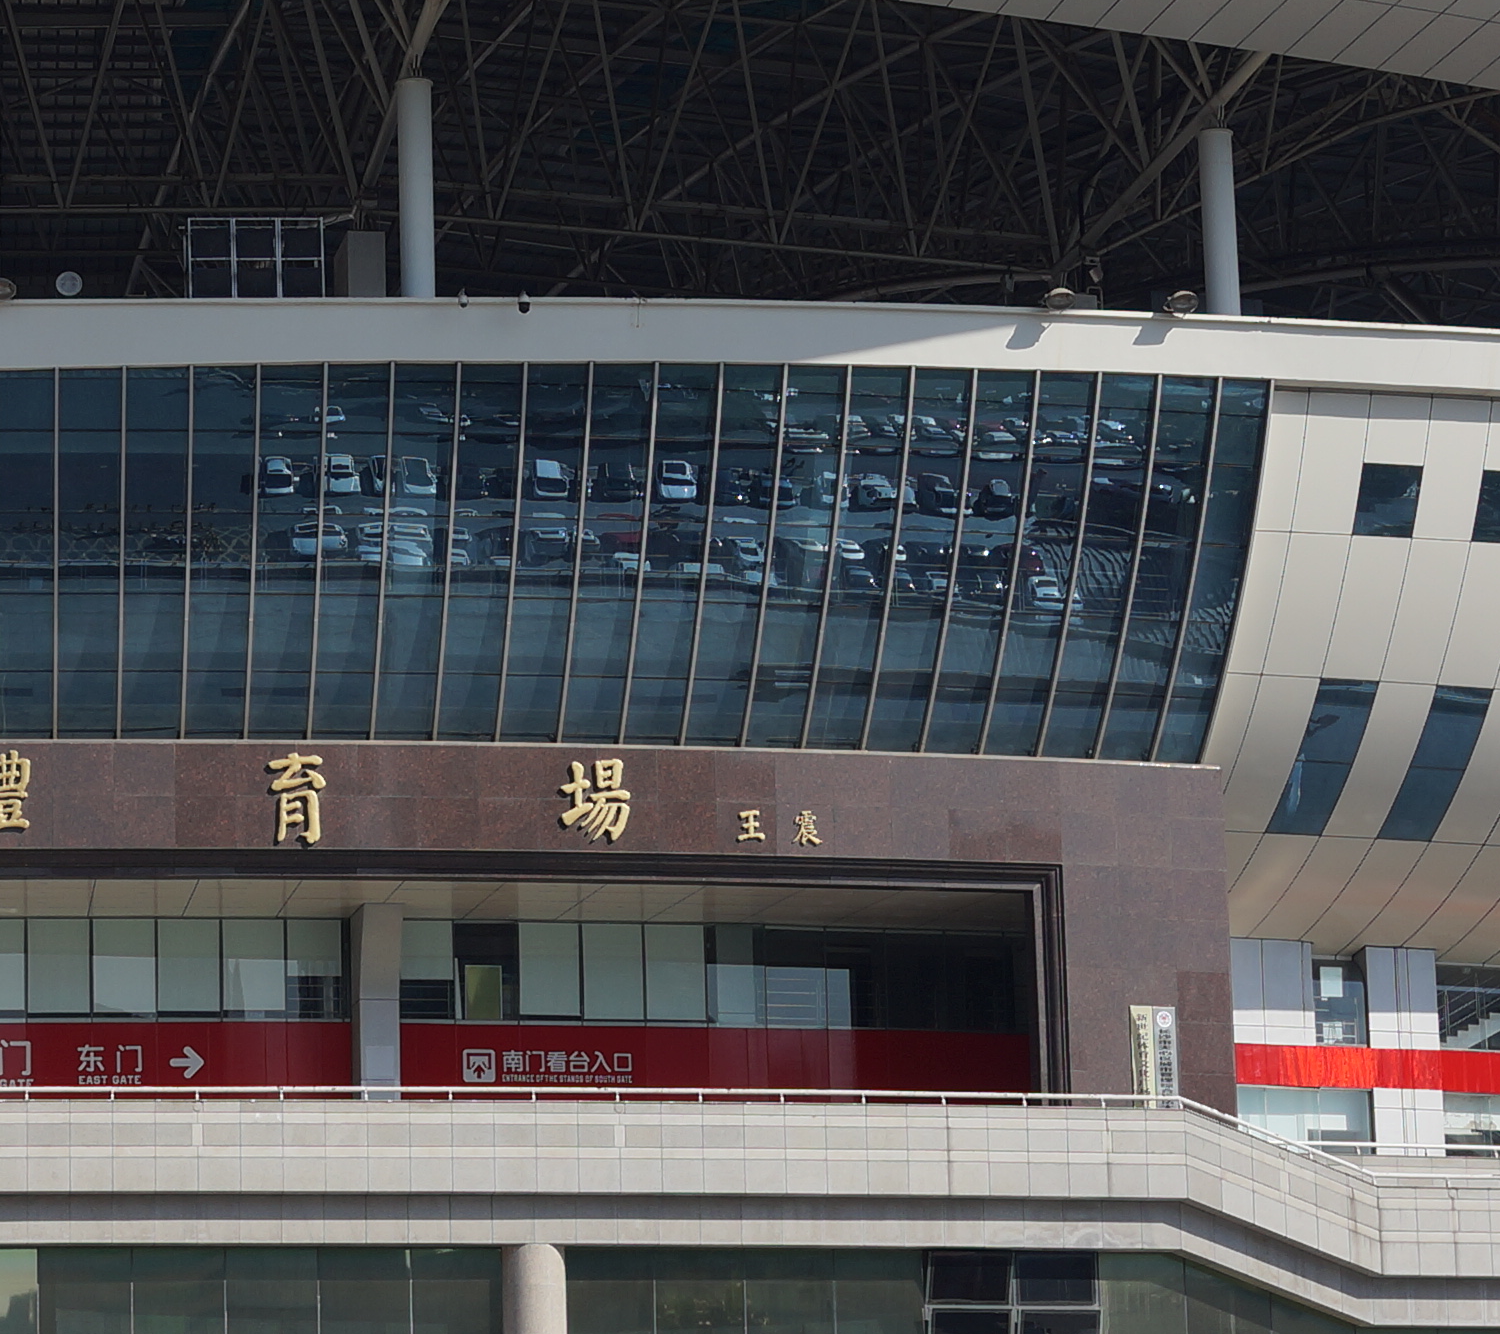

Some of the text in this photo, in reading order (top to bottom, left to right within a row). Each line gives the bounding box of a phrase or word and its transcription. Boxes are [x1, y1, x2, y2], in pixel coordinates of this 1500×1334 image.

[77, 1044, 143, 1073] 东门
[502, 1050, 633, 1073] 南门看台入口
[78, 1075, 142, 1085] EAST GATE
